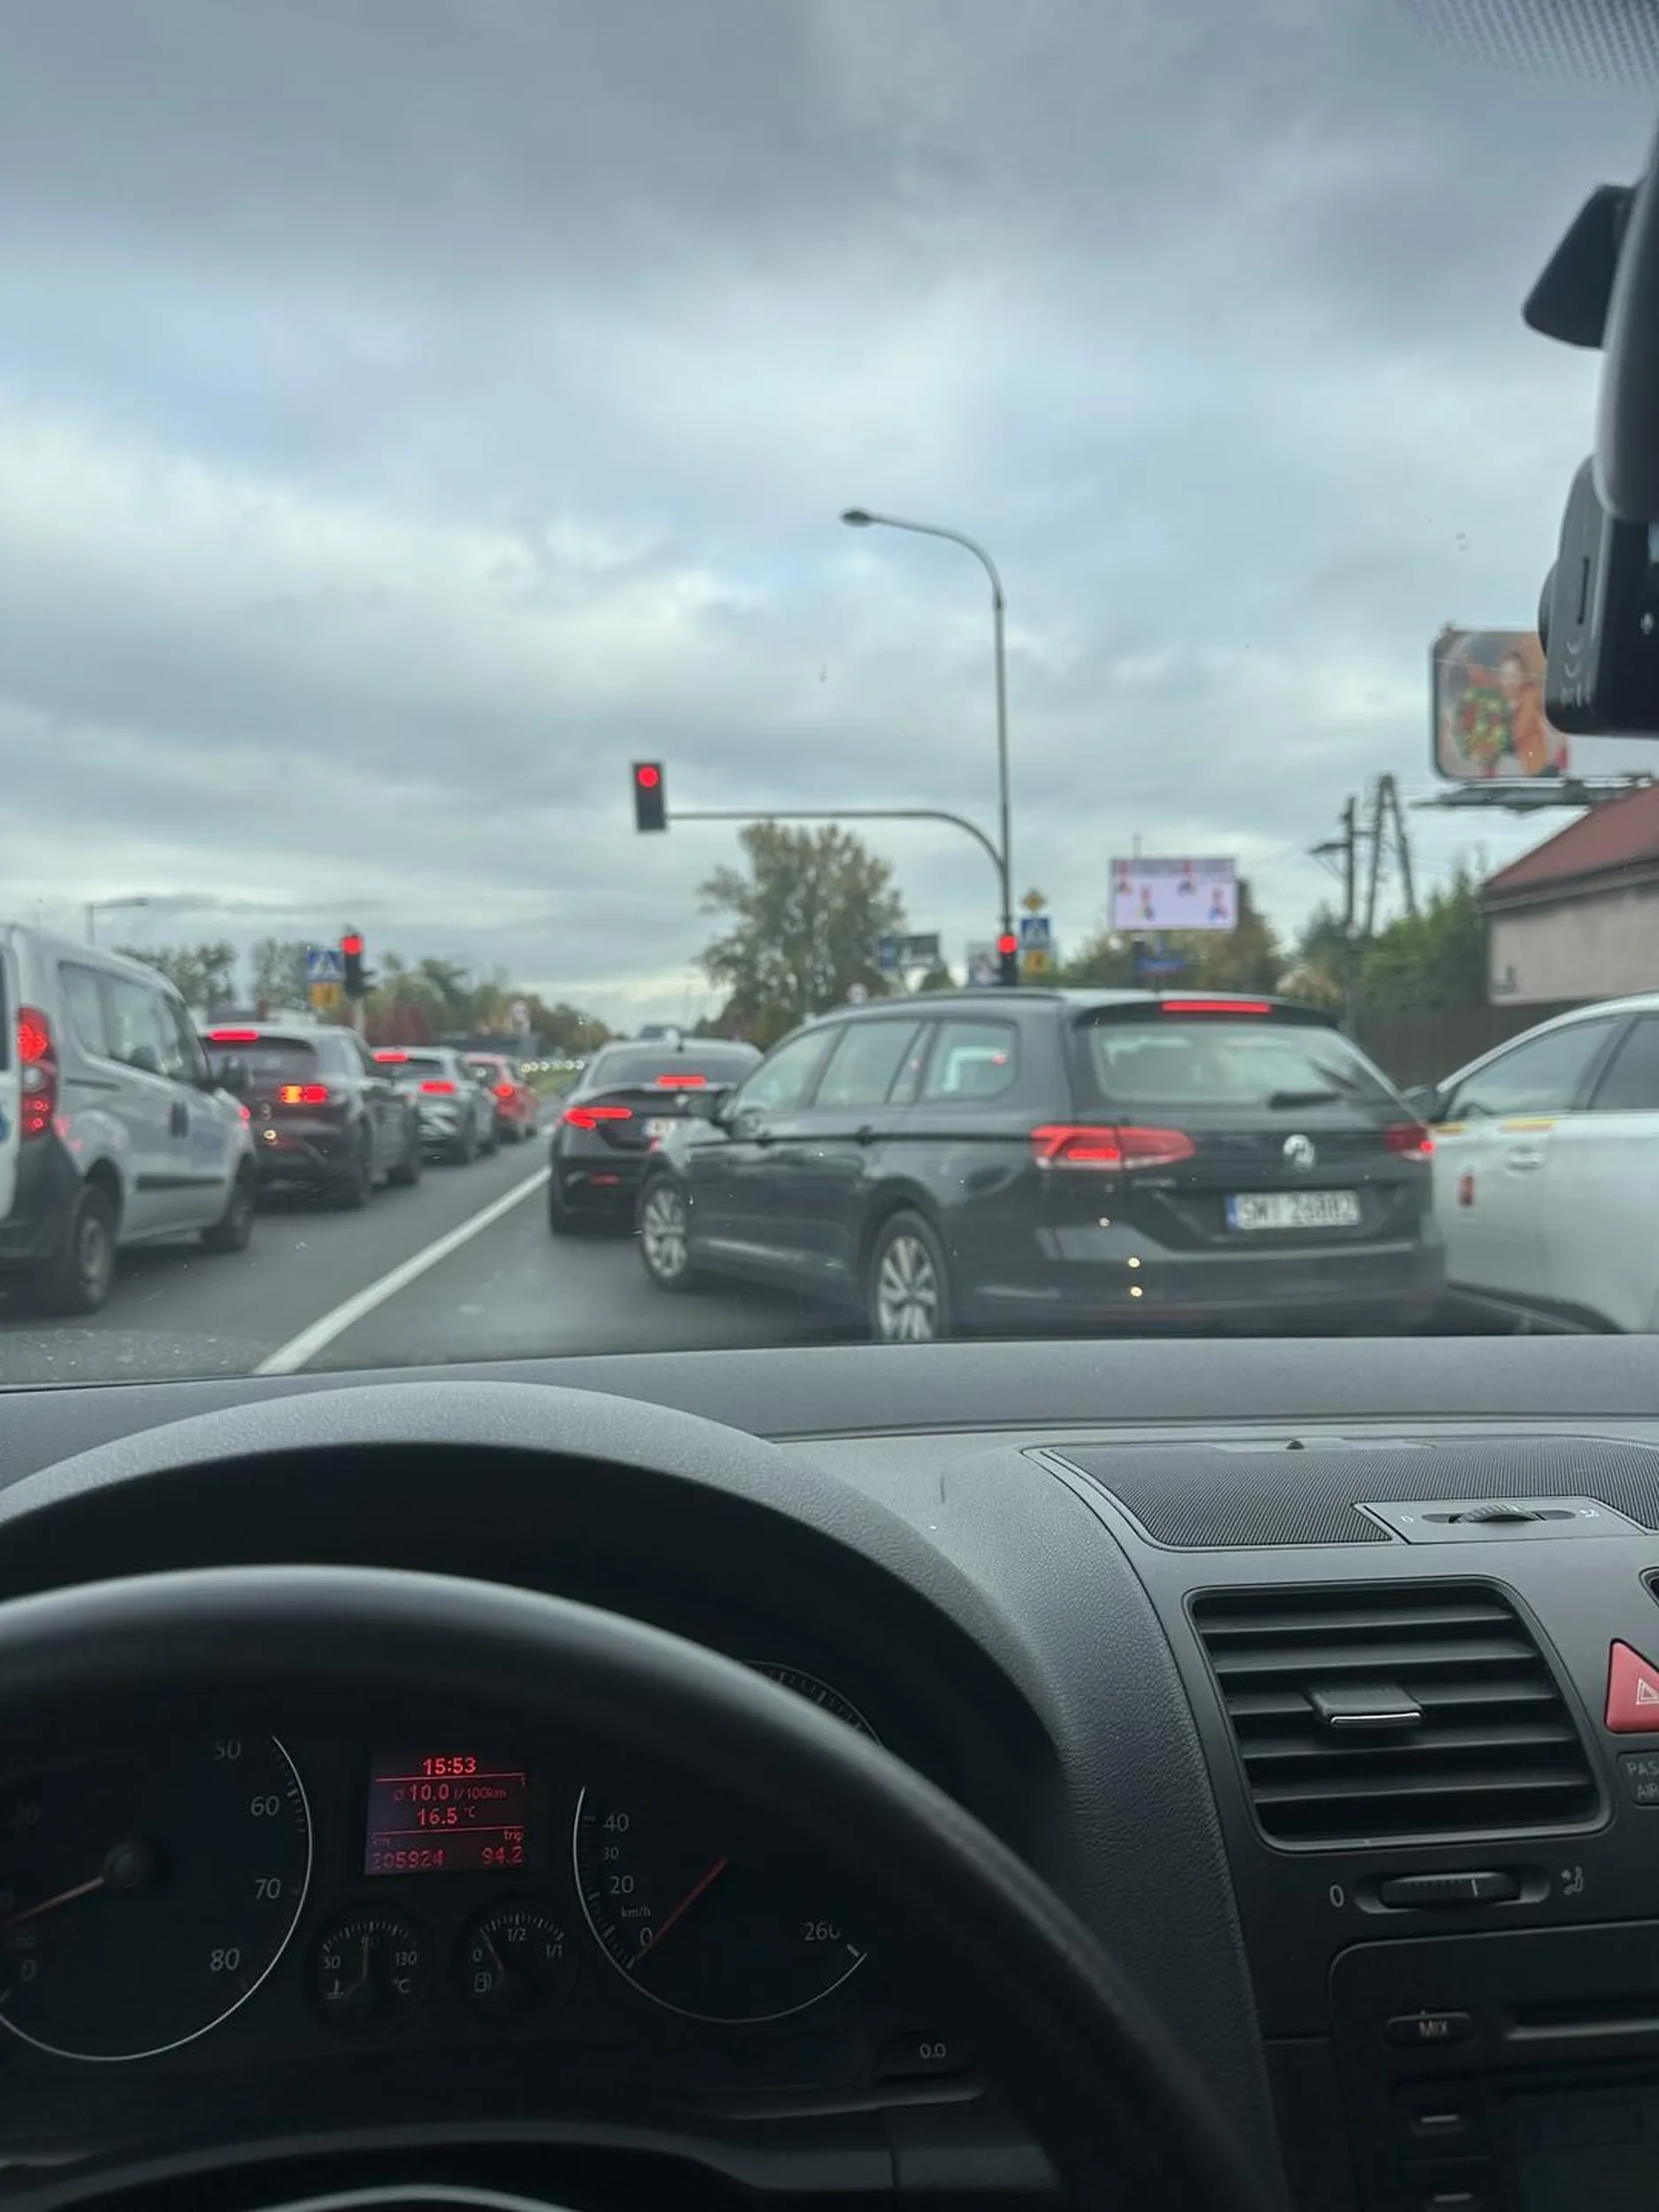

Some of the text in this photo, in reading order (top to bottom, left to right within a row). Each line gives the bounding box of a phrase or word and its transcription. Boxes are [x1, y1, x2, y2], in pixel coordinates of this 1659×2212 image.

[213, 1739, 242, 1760] 50
[422, 1756, 478, 1776] 15:53
[410, 1783, 450, 1802] 10.0
[249, 1795, 281, 1816] 60
[417, 1806, 458, 1826] 16.5
[603, 1812, 630, 1832] 40
[481, 1845, 524, 1864] 94.2
[602, 1846, 620, 1861] 30
[254, 1877, 282, 1900] 70
[609, 1874, 635, 1894] 20
[620, 1904, 652, 1918] km/h
[506, 1927, 527, 1942] 1/2
[639, 1926, 654, 1947] 0
[209, 1948, 242, 1972] 80
[395, 1951, 418, 1966] 130
[472, 1947, 484, 1962] 0
[1417, 2019, 1450, 2039] MIX
[919, 2043, 946, 2059] 0.0
